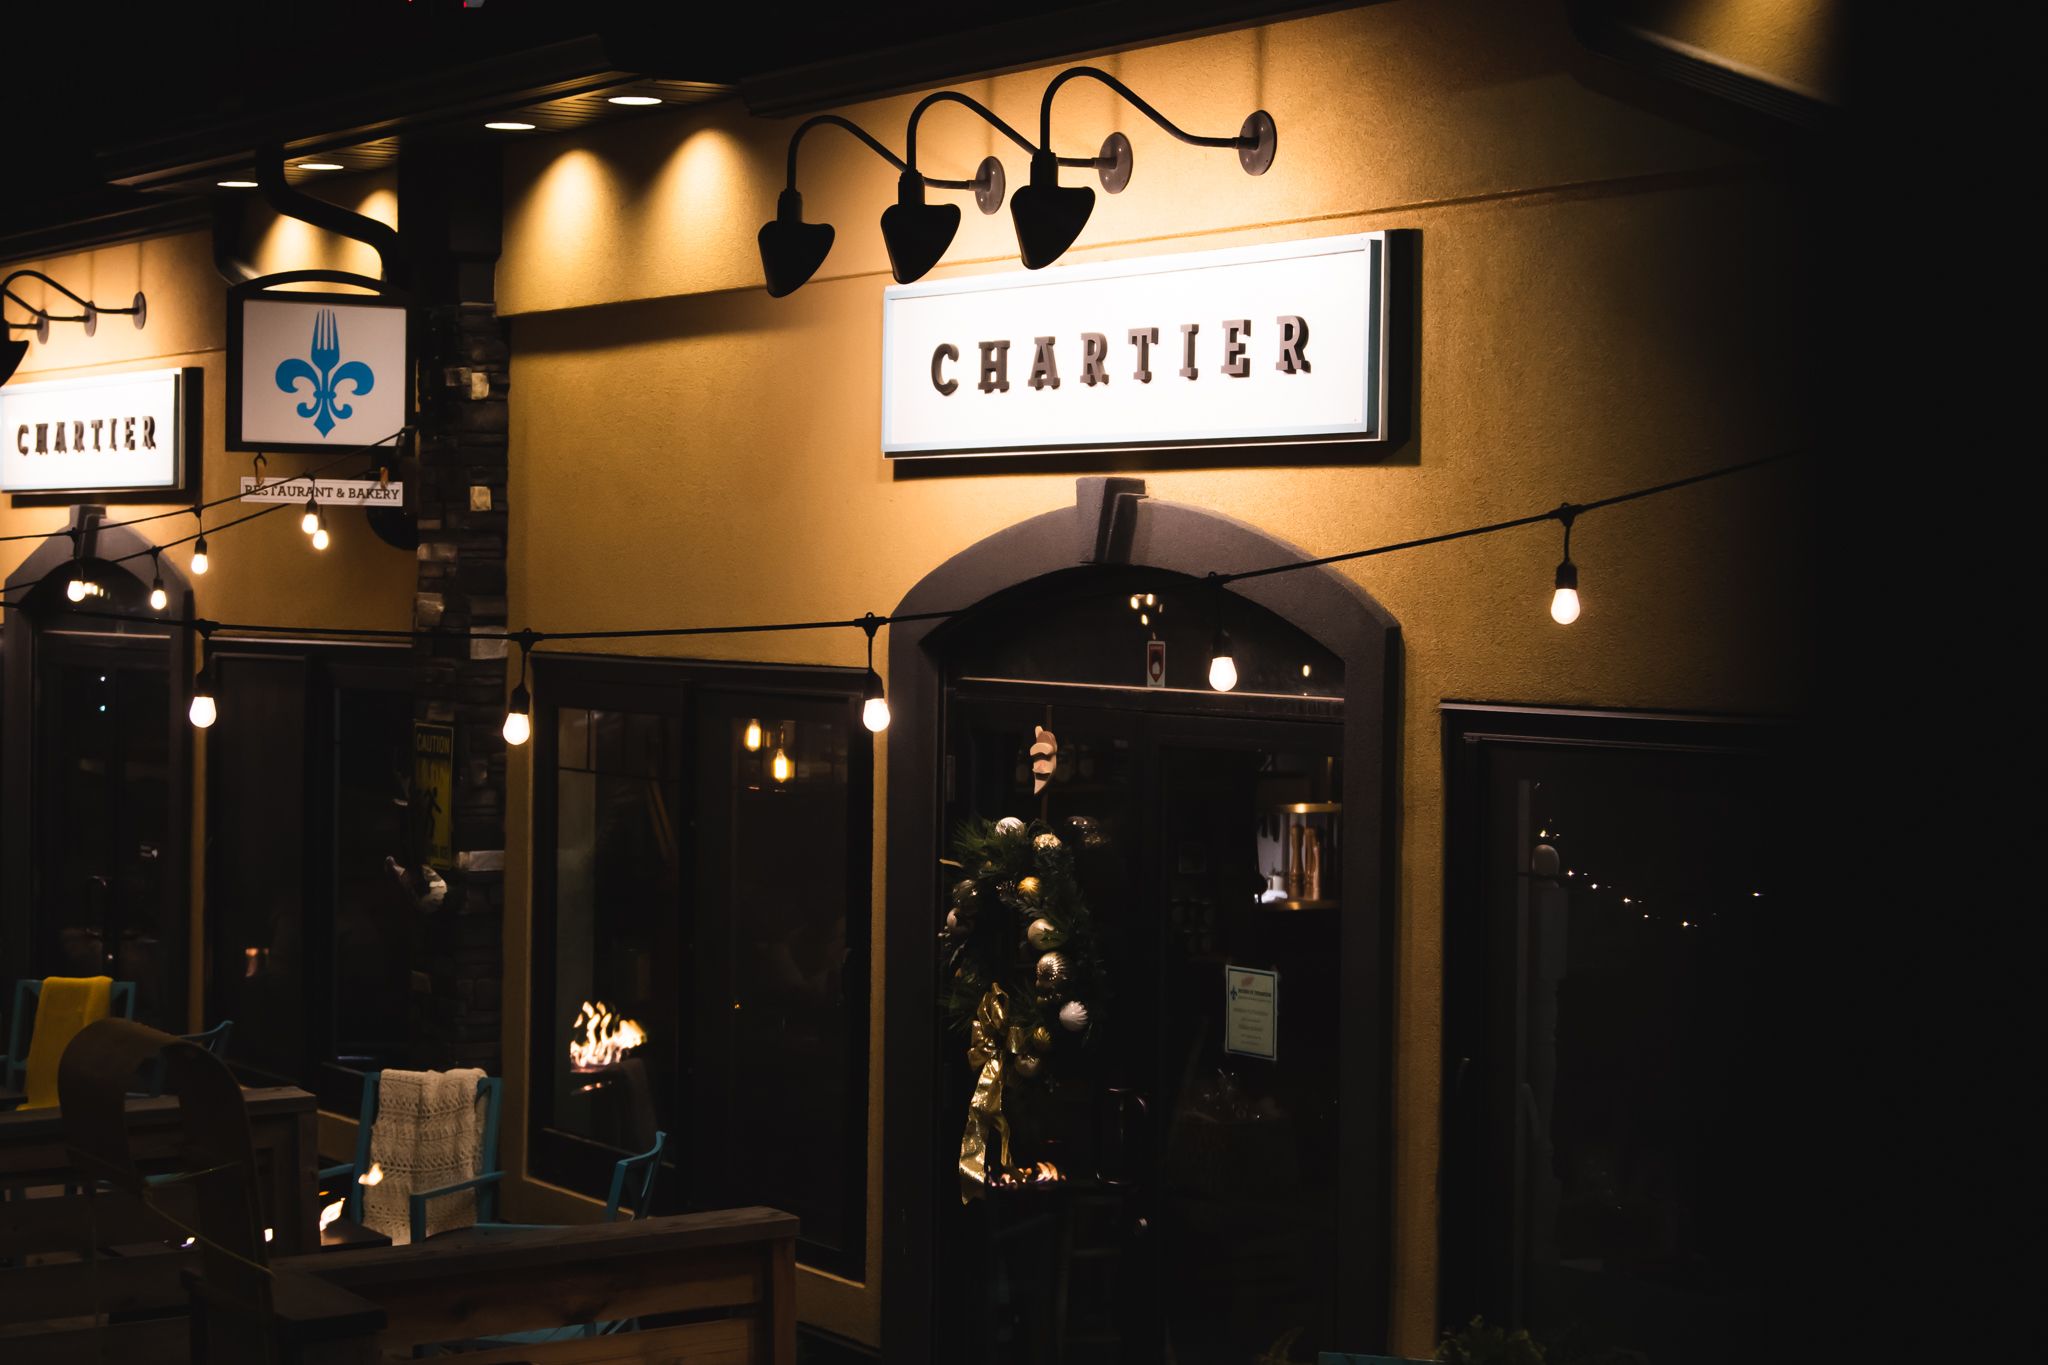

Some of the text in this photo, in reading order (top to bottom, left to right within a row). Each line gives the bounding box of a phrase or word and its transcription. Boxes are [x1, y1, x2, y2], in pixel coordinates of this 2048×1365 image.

[930, 314, 1312, 397] CHARTIER
[17, 415, 157, 457] CHARTIER
[244, 484, 400, 500] RESTAURANT & BAKERY
[416, 733, 450, 753] CAUTION
